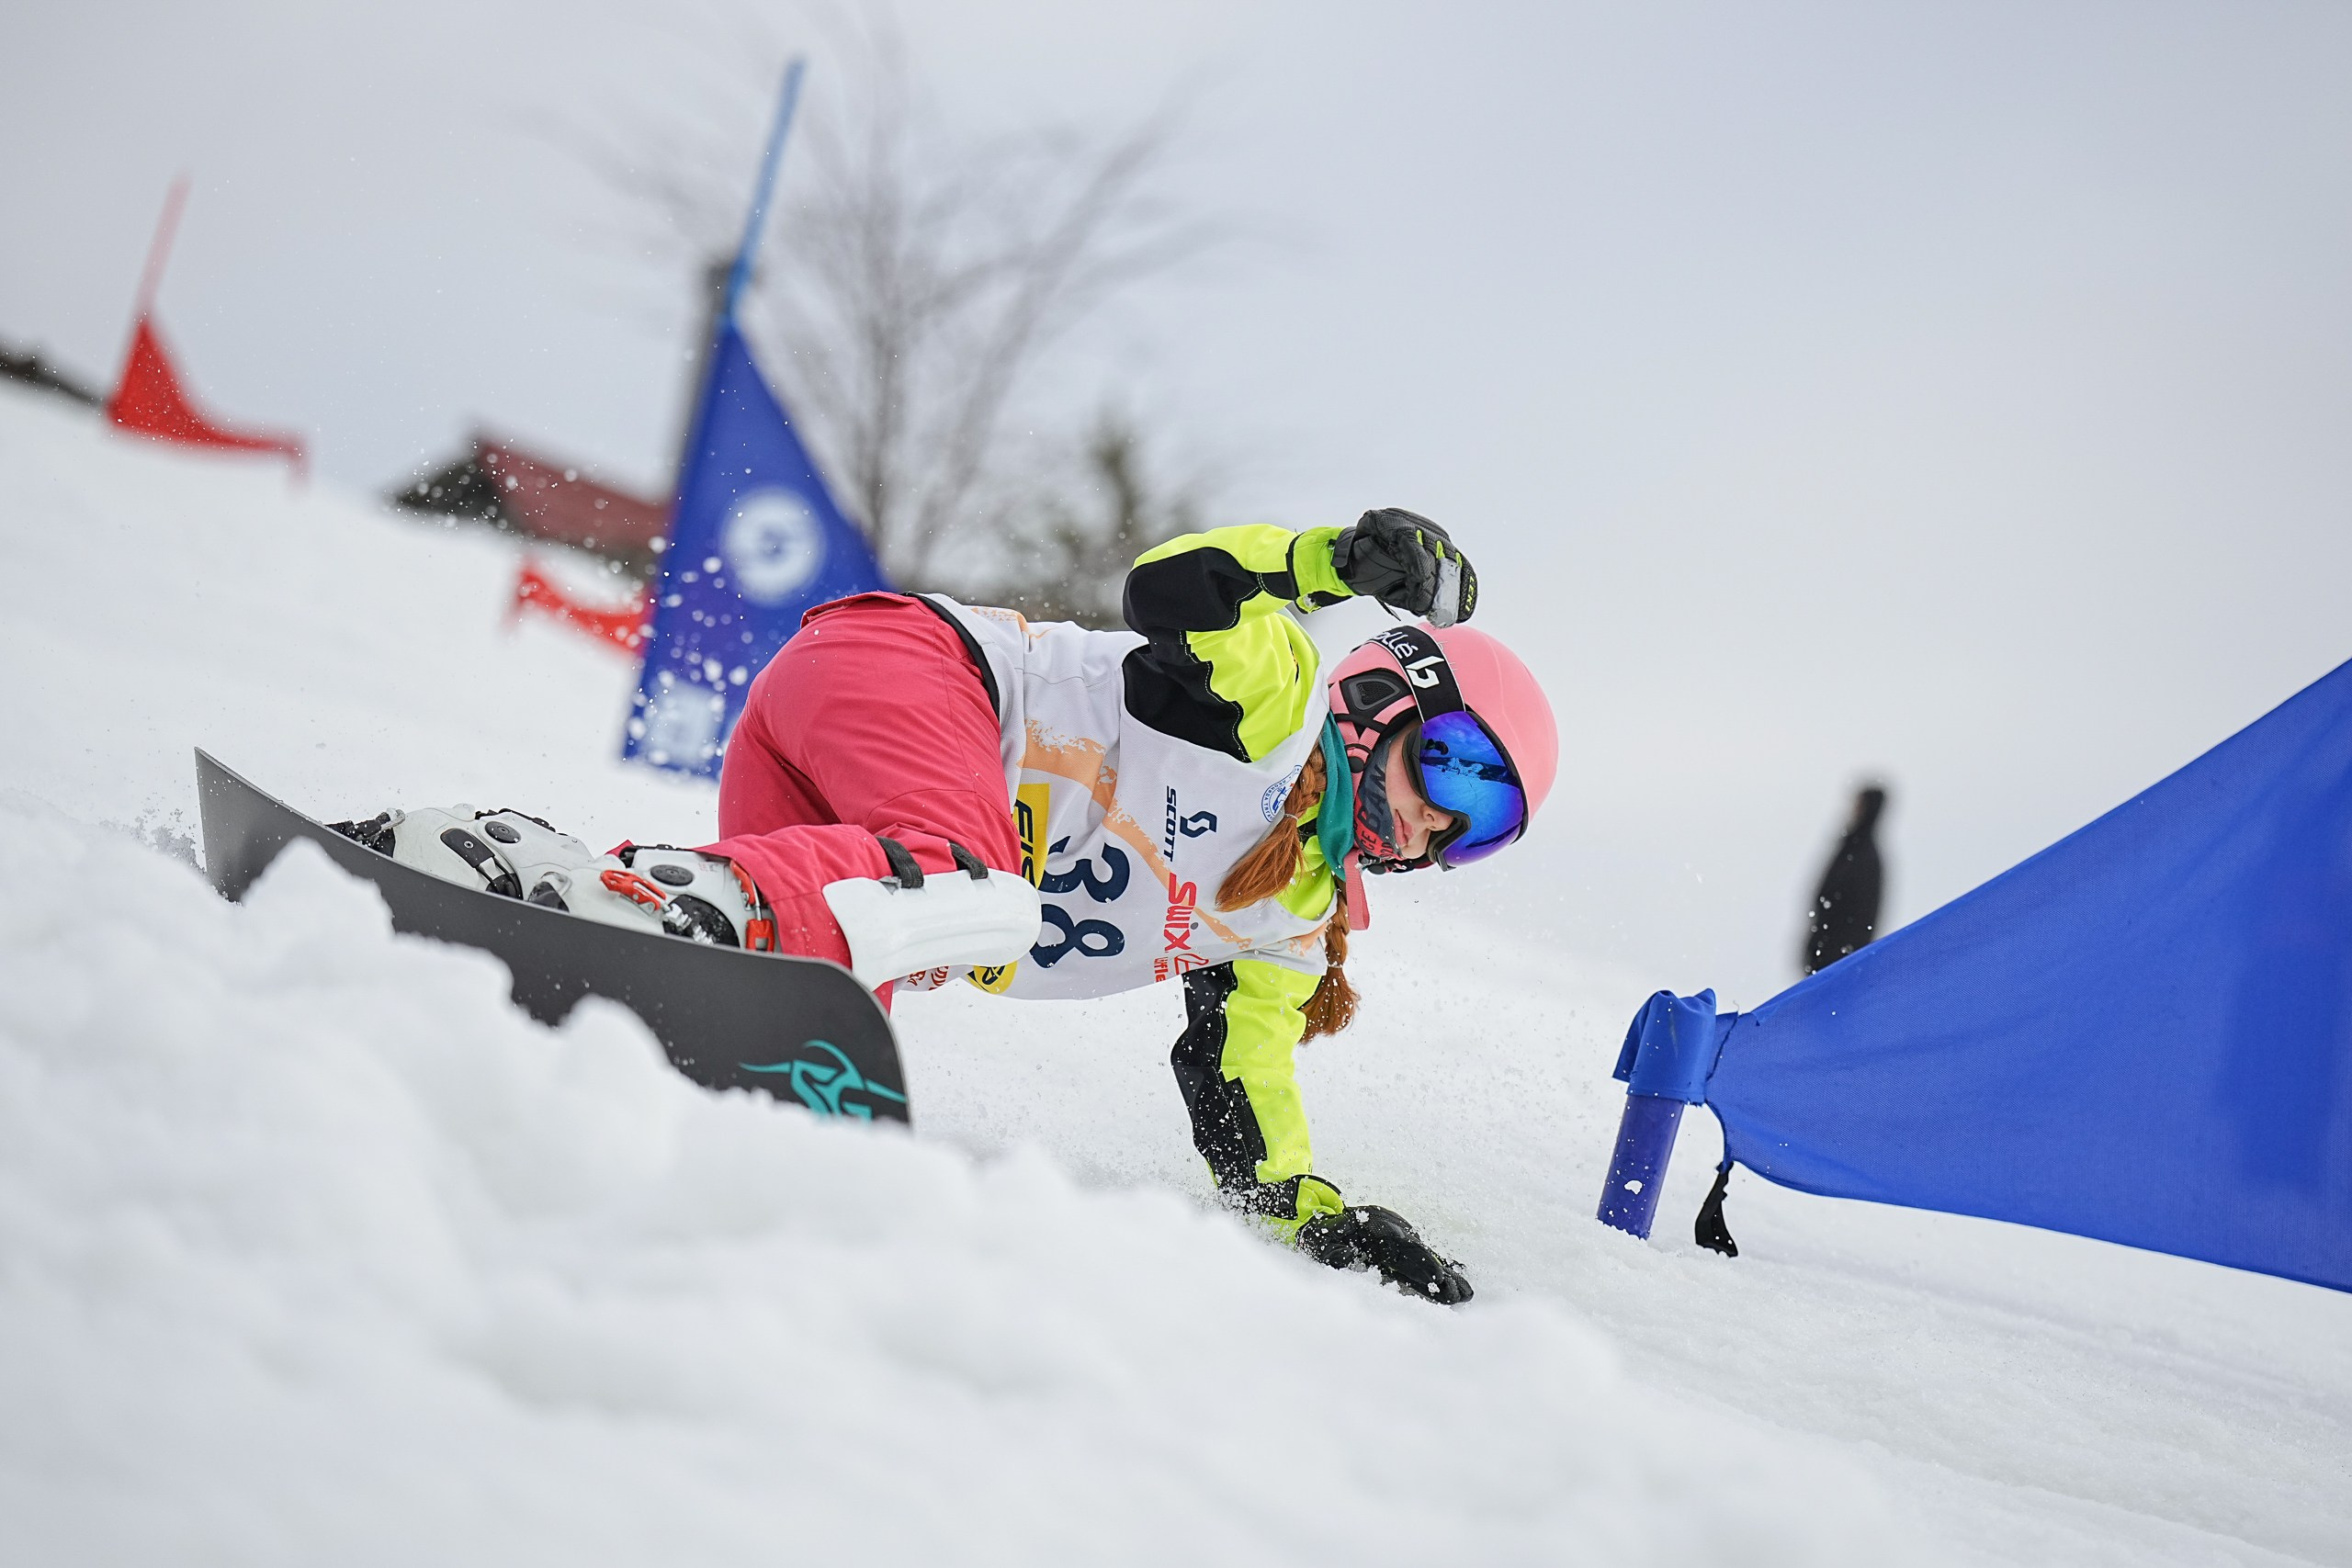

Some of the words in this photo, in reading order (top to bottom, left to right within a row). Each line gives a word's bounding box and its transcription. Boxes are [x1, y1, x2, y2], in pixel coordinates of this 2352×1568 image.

[1464, 576, 1475, 612] LEKI
[1374, 631, 1419, 660] ollé
[1163, 785, 1177, 863] SCOTT
[1030, 836, 1131, 969] 38
